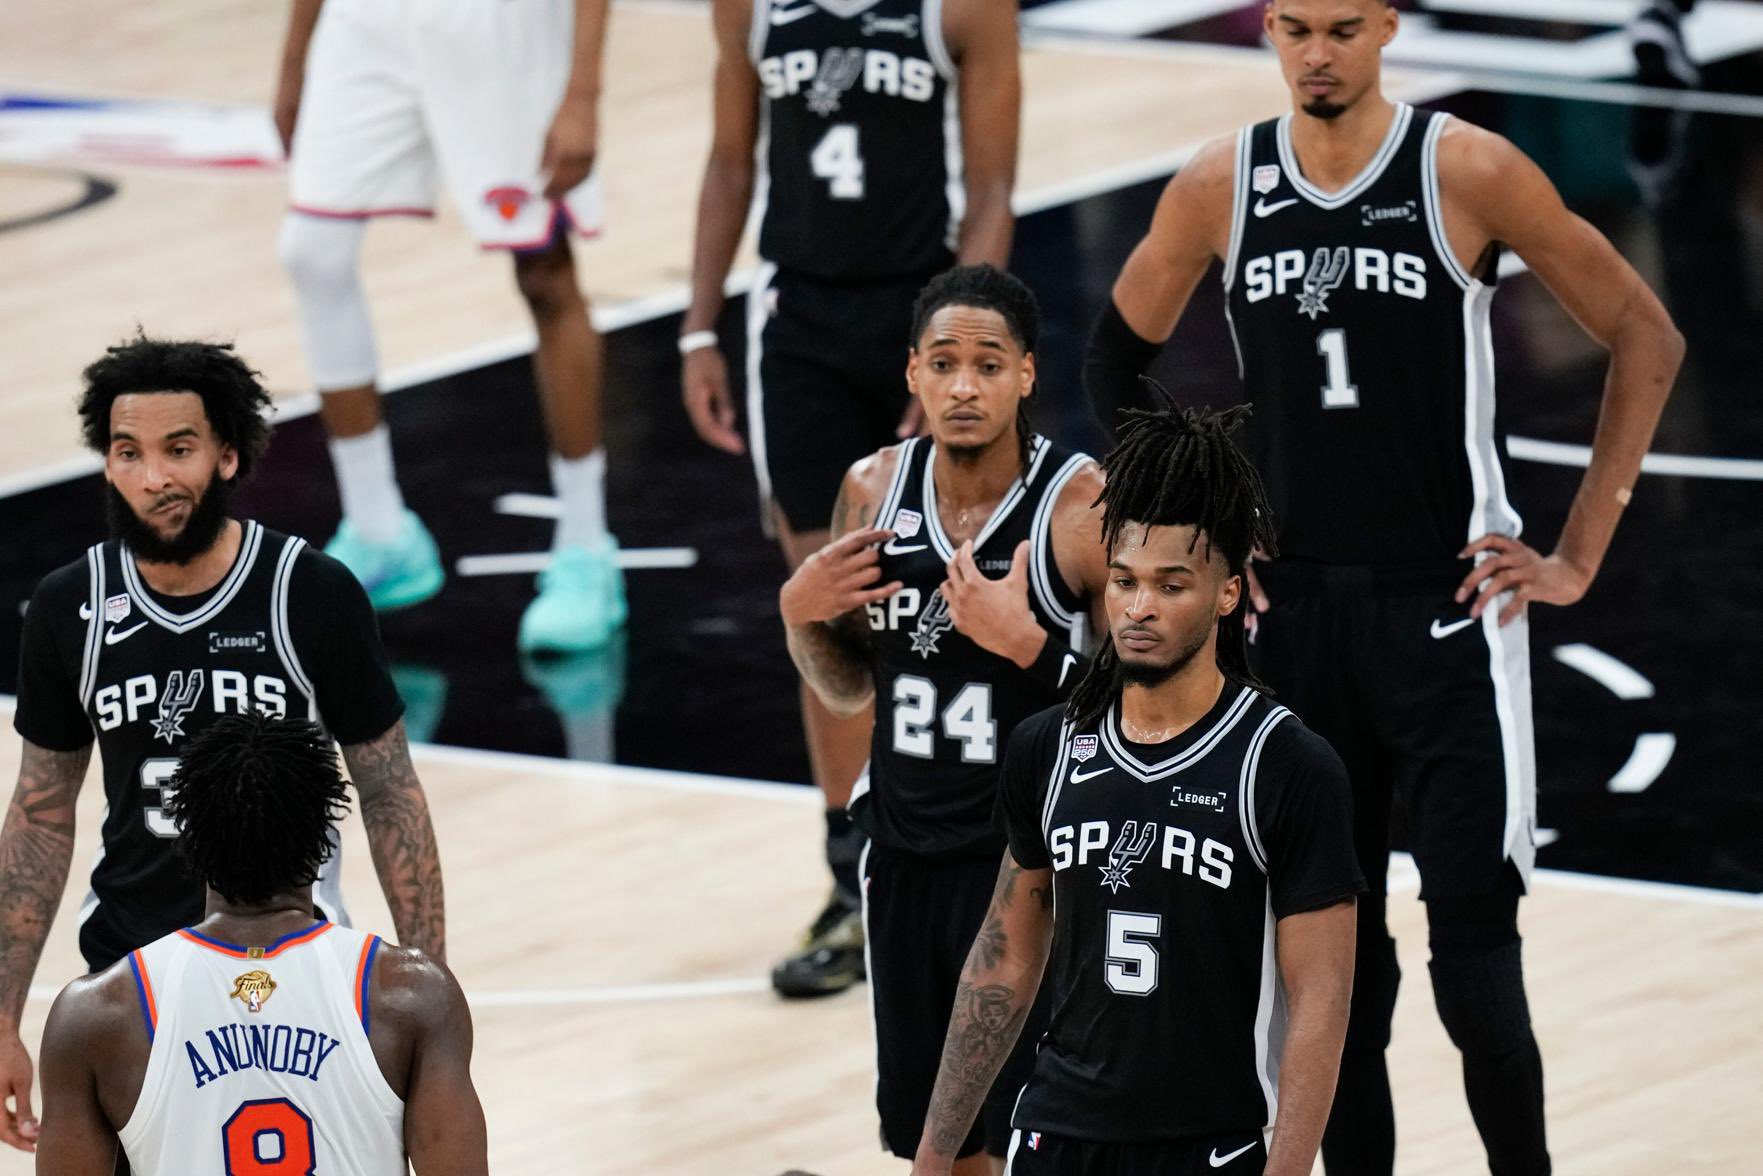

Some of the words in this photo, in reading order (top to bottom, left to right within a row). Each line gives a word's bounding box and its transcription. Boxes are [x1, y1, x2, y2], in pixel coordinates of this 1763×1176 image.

[758, 47, 934, 116] SPURS
[811, 124, 863, 198] 4
[1245, 247, 1426, 319] SPURS
[1317, 328, 1359, 409] 1
[980, 559, 1011, 570] LEDGE
[216, 637, 258, 648] LEDGER
[95, 669, 287, 744] SPURS
[893, 673, 997, 764] 24
[1178, 792, 1218, 806] LEDGER
[1051, 820, 1233, 895] SPURS
[1104, 909, 1162, 997] 5
[185, 1023, 340, 1089] ANUNOBY
